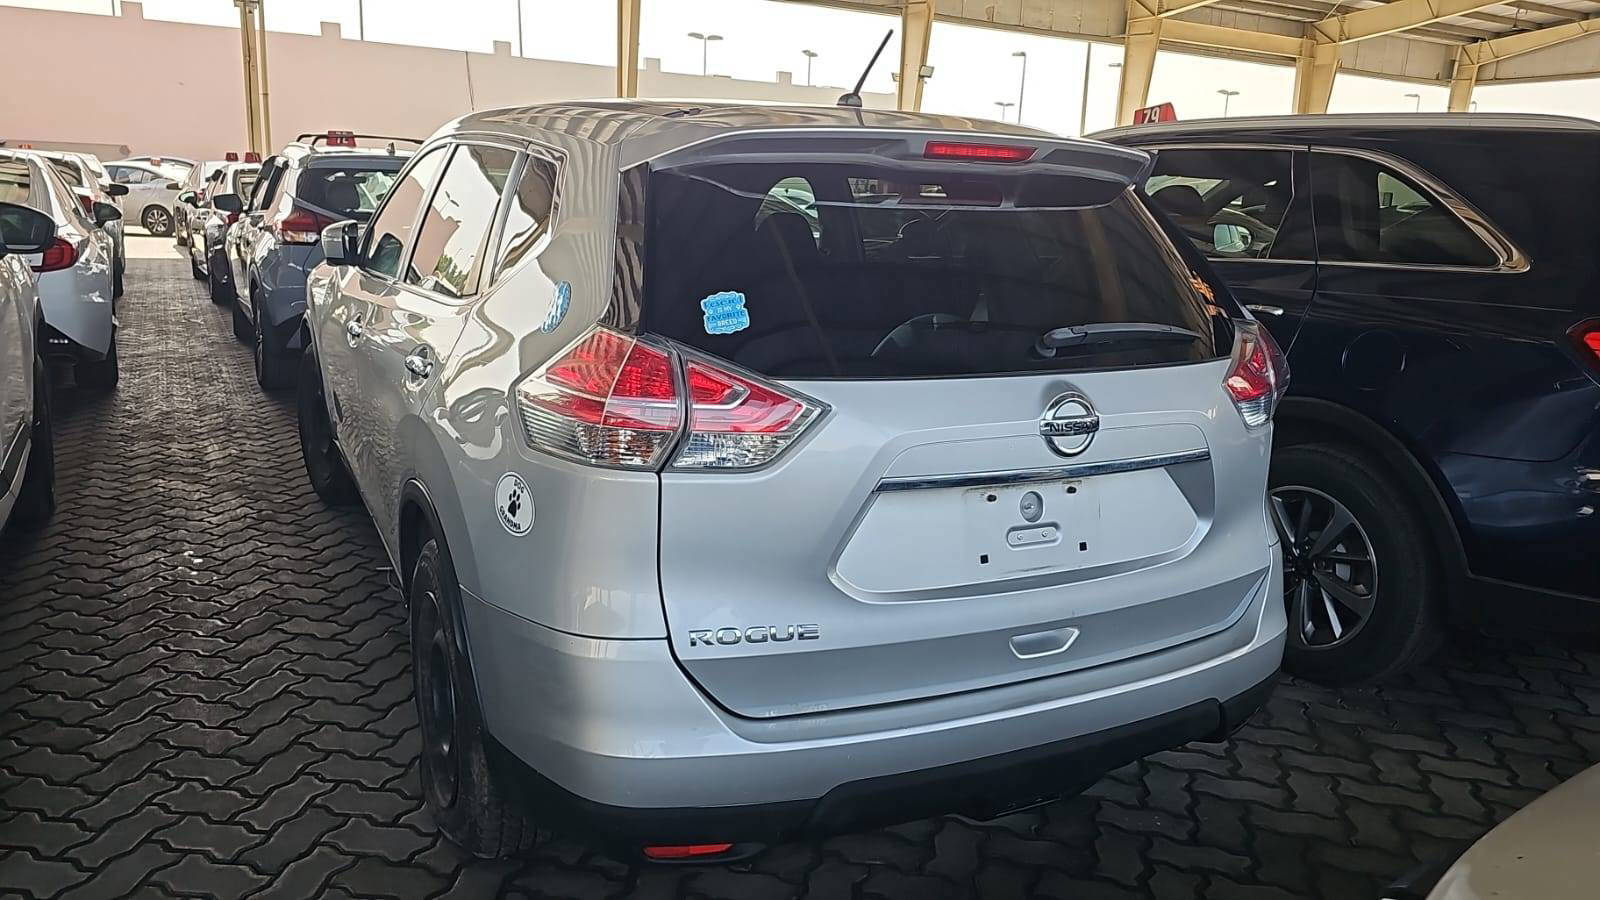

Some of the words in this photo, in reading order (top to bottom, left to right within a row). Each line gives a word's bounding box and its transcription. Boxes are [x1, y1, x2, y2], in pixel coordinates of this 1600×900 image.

[1143, 106, 1160, 124] 79
[1049, 418, 1097, 432] NISSAN
[513, 478, 525, 494] DOG
[499, 505, 522, 531] GRANDMA
[687, 623, 820, 647] ROGUE
